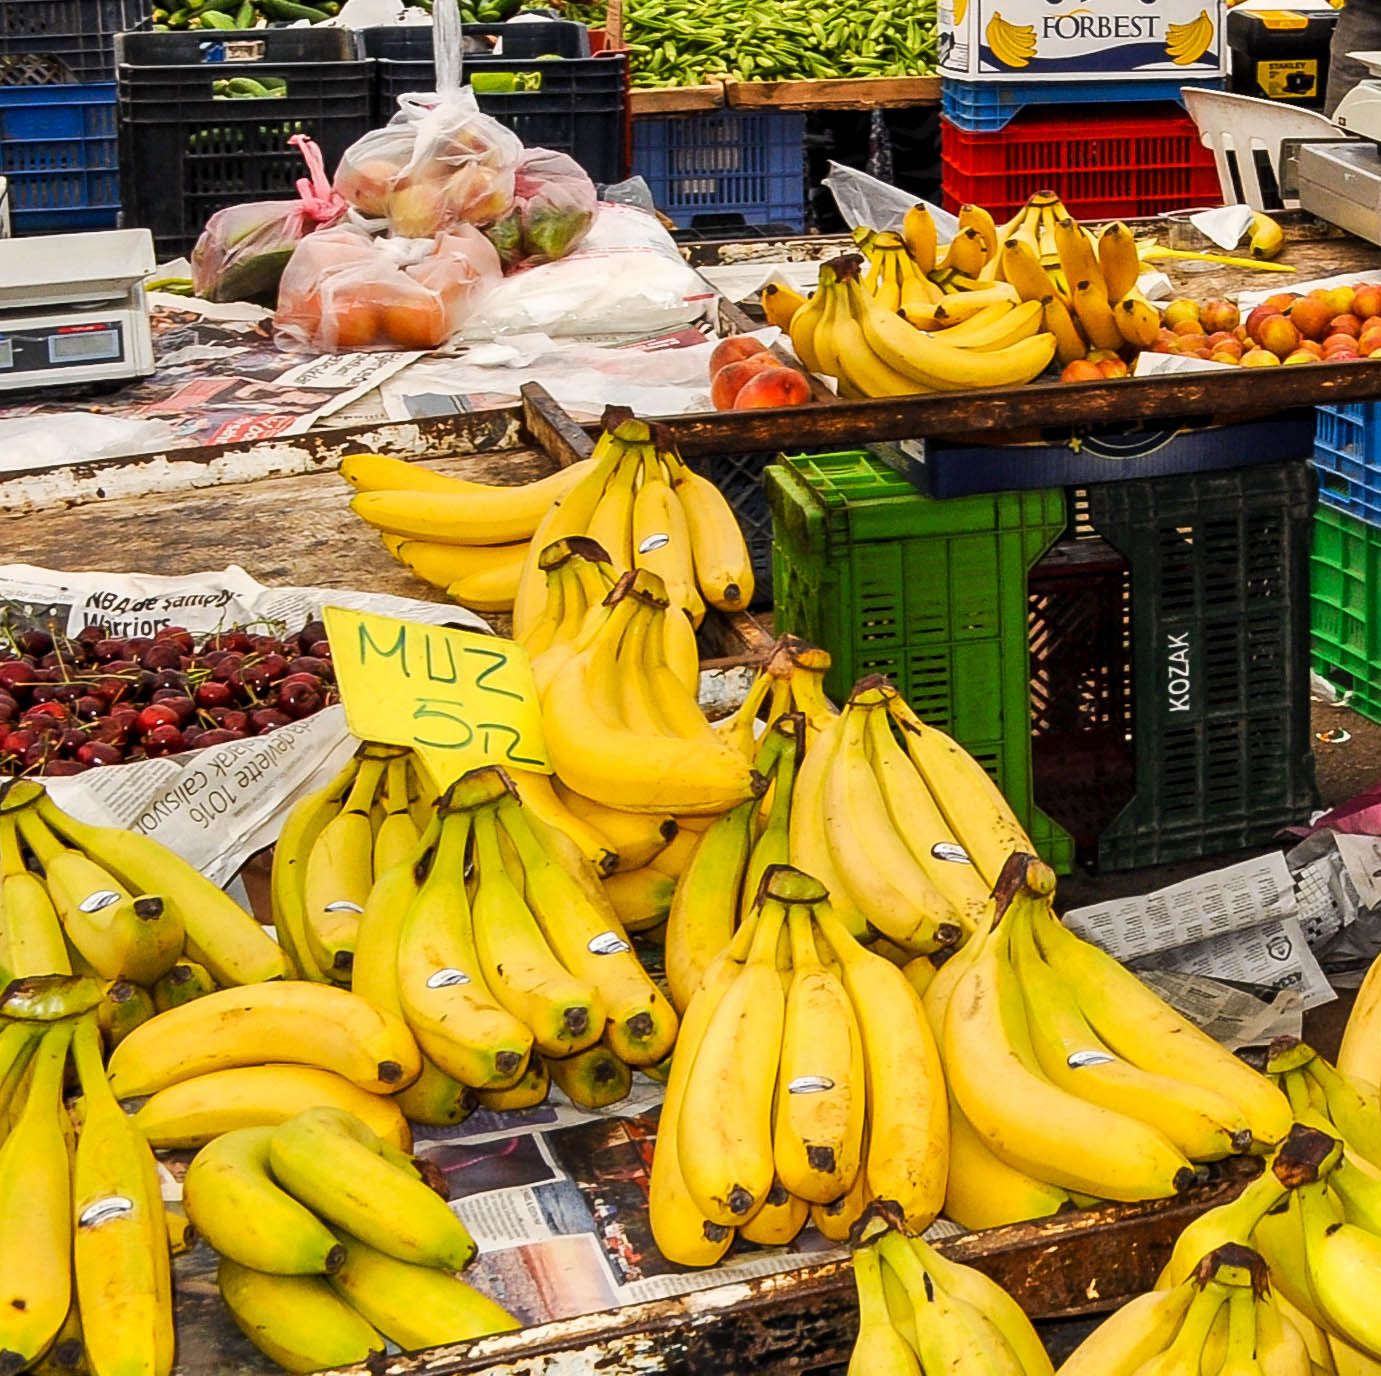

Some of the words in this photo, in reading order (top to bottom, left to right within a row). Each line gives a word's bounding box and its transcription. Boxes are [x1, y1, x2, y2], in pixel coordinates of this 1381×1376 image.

[1042, 14, 1161, 39] FORBEST
[358, 621, 525, 702] MUZ
[1167, 632, 1190, 712] KOZAK
[235, 733, 296, 789] devlette
[189, 784, 238, 830] 1016
